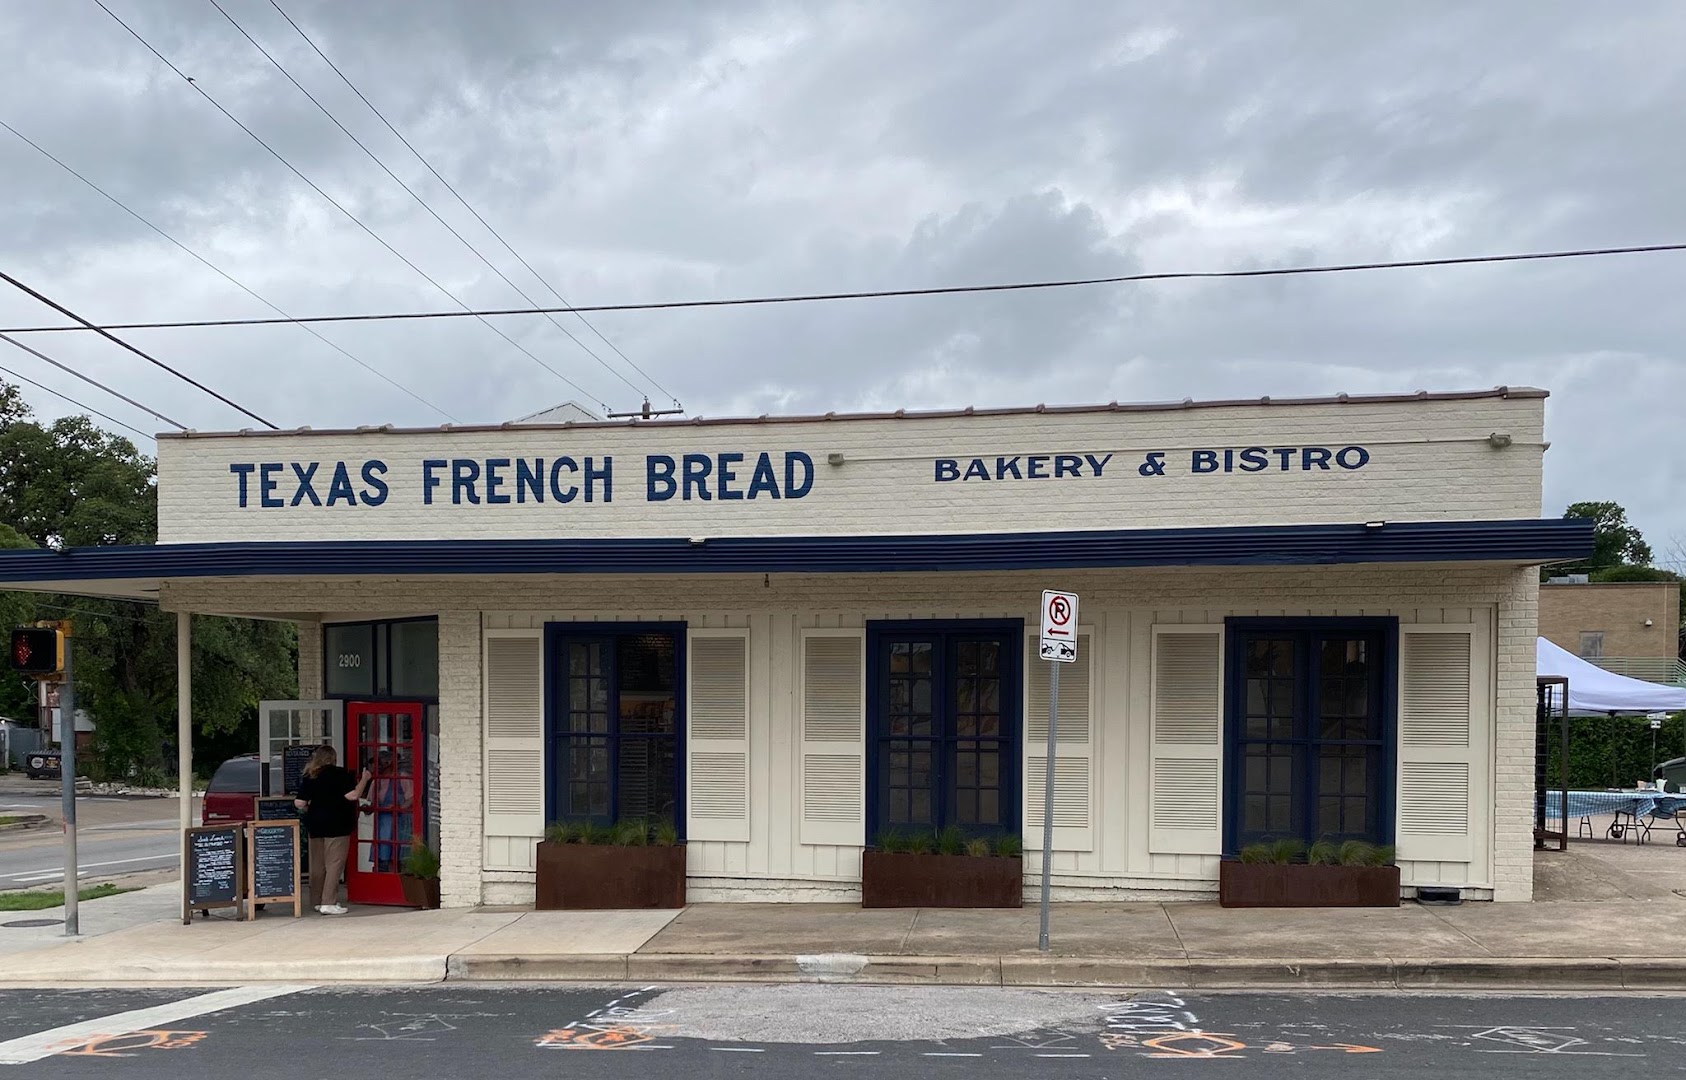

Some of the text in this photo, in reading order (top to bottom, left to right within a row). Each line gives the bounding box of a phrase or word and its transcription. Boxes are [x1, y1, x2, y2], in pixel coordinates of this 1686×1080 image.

[230, 452, 815, 508] TEXAS FRENCH BREAD
[935, 447, 1370, 482] BAKERY & BISTRO
[338, 654, 361, 668] 2900
